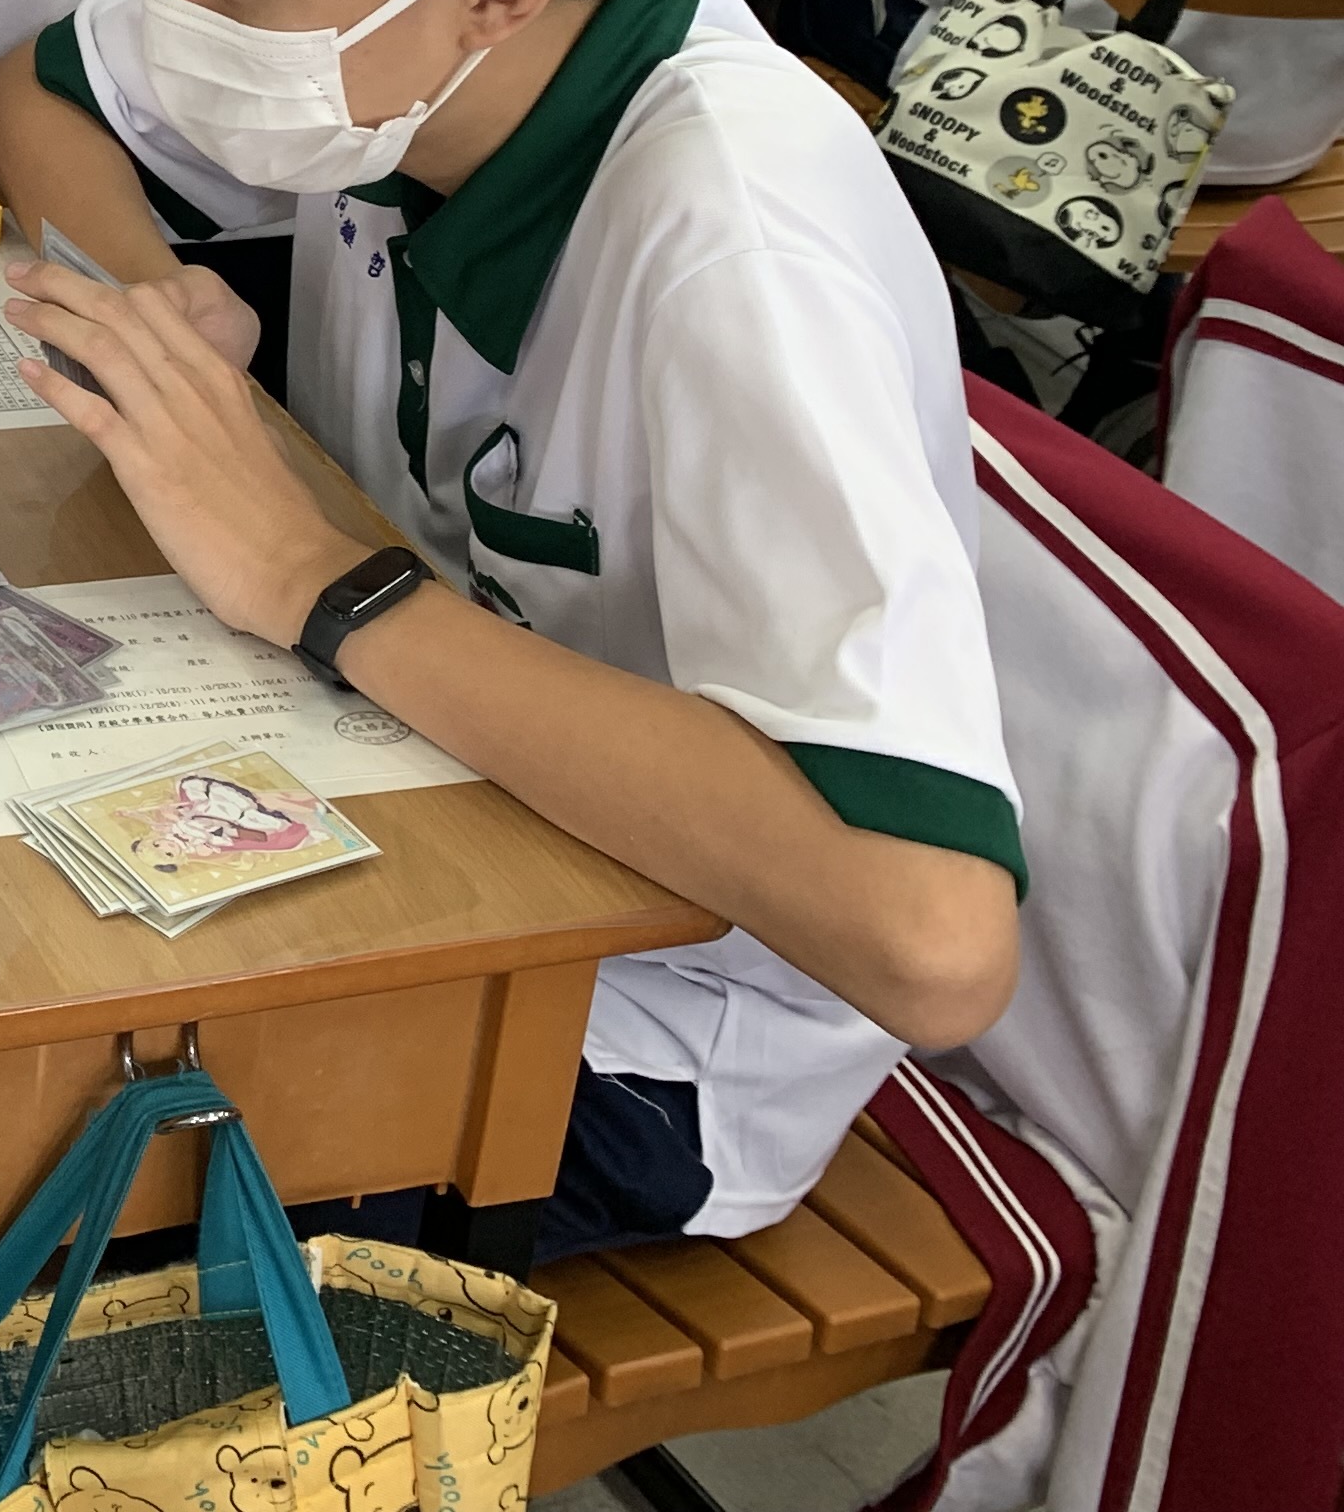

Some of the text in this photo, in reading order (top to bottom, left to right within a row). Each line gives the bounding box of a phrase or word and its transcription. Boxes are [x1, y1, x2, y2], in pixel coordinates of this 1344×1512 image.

[1089, 46, 1164, 94] SNOOPY
[1109, 77, 1124, 94] &
[908, 101, 981, 143] SNOOPY
[1060, 68, 1158, 135] Woodstock
[887, 128, 973, 178] Woodstock
[923, 127, 937, 143] &
